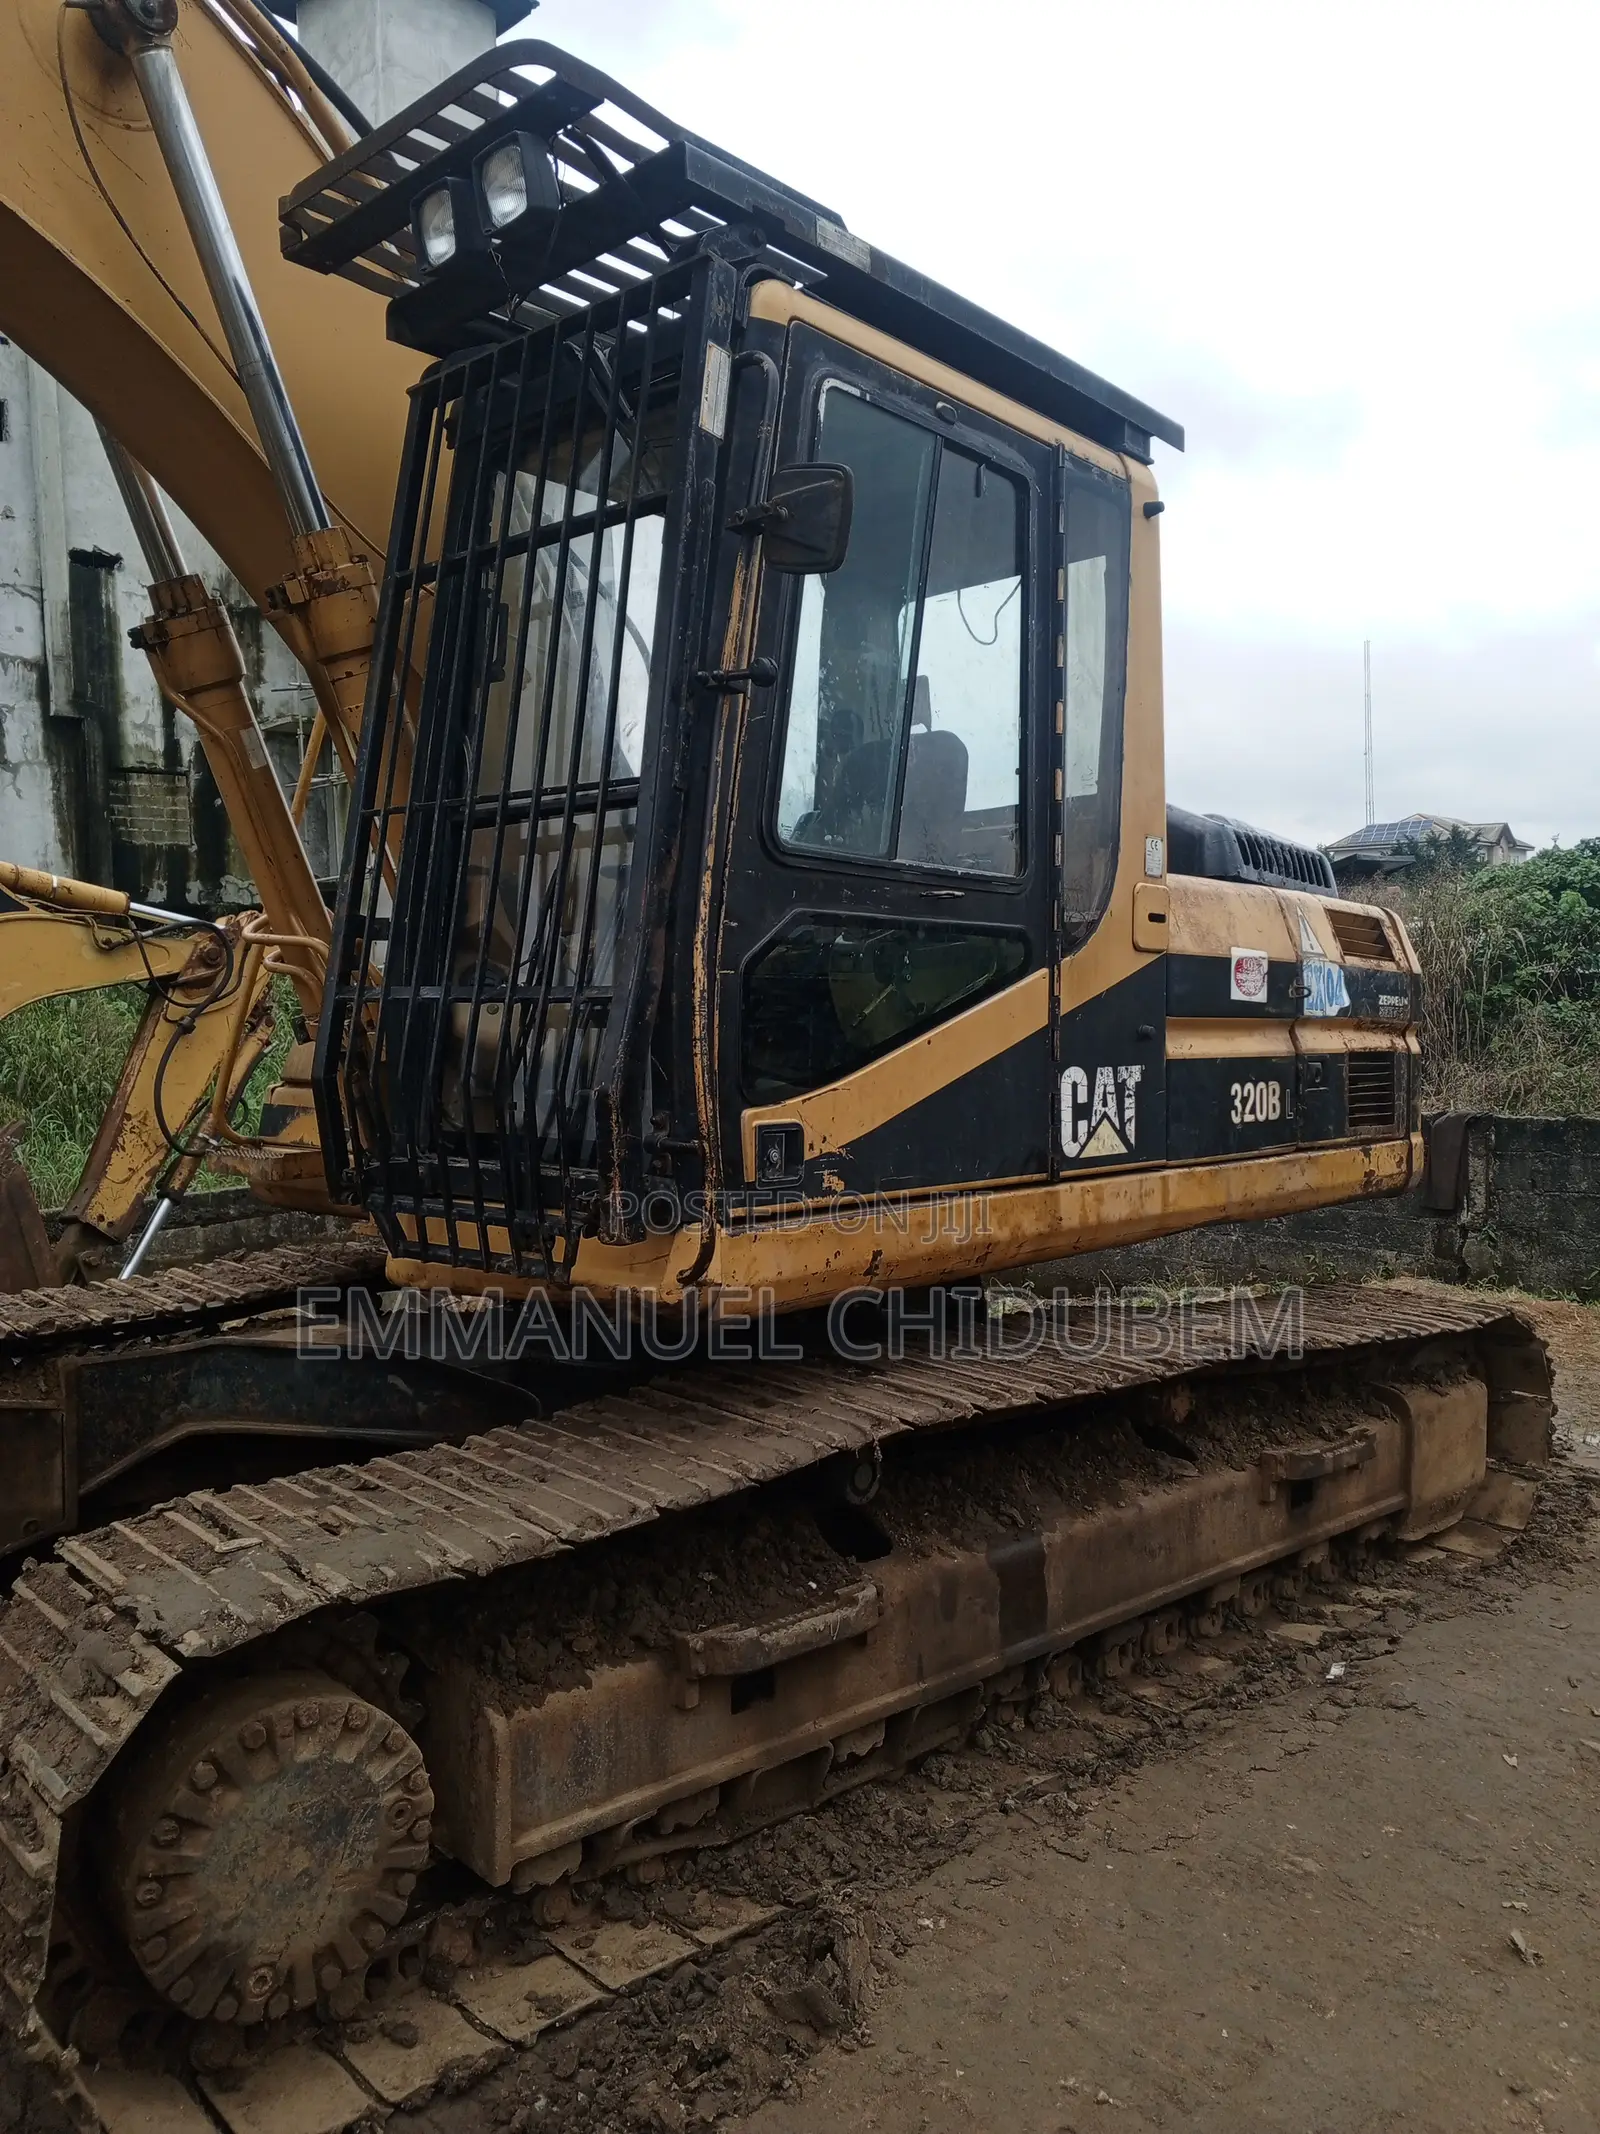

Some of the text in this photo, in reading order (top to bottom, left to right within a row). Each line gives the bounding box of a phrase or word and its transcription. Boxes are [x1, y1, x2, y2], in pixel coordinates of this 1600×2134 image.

[1060, 1064, 1142, 1158] CAT
[1230, 1080, 1294, 1124] 320B L
